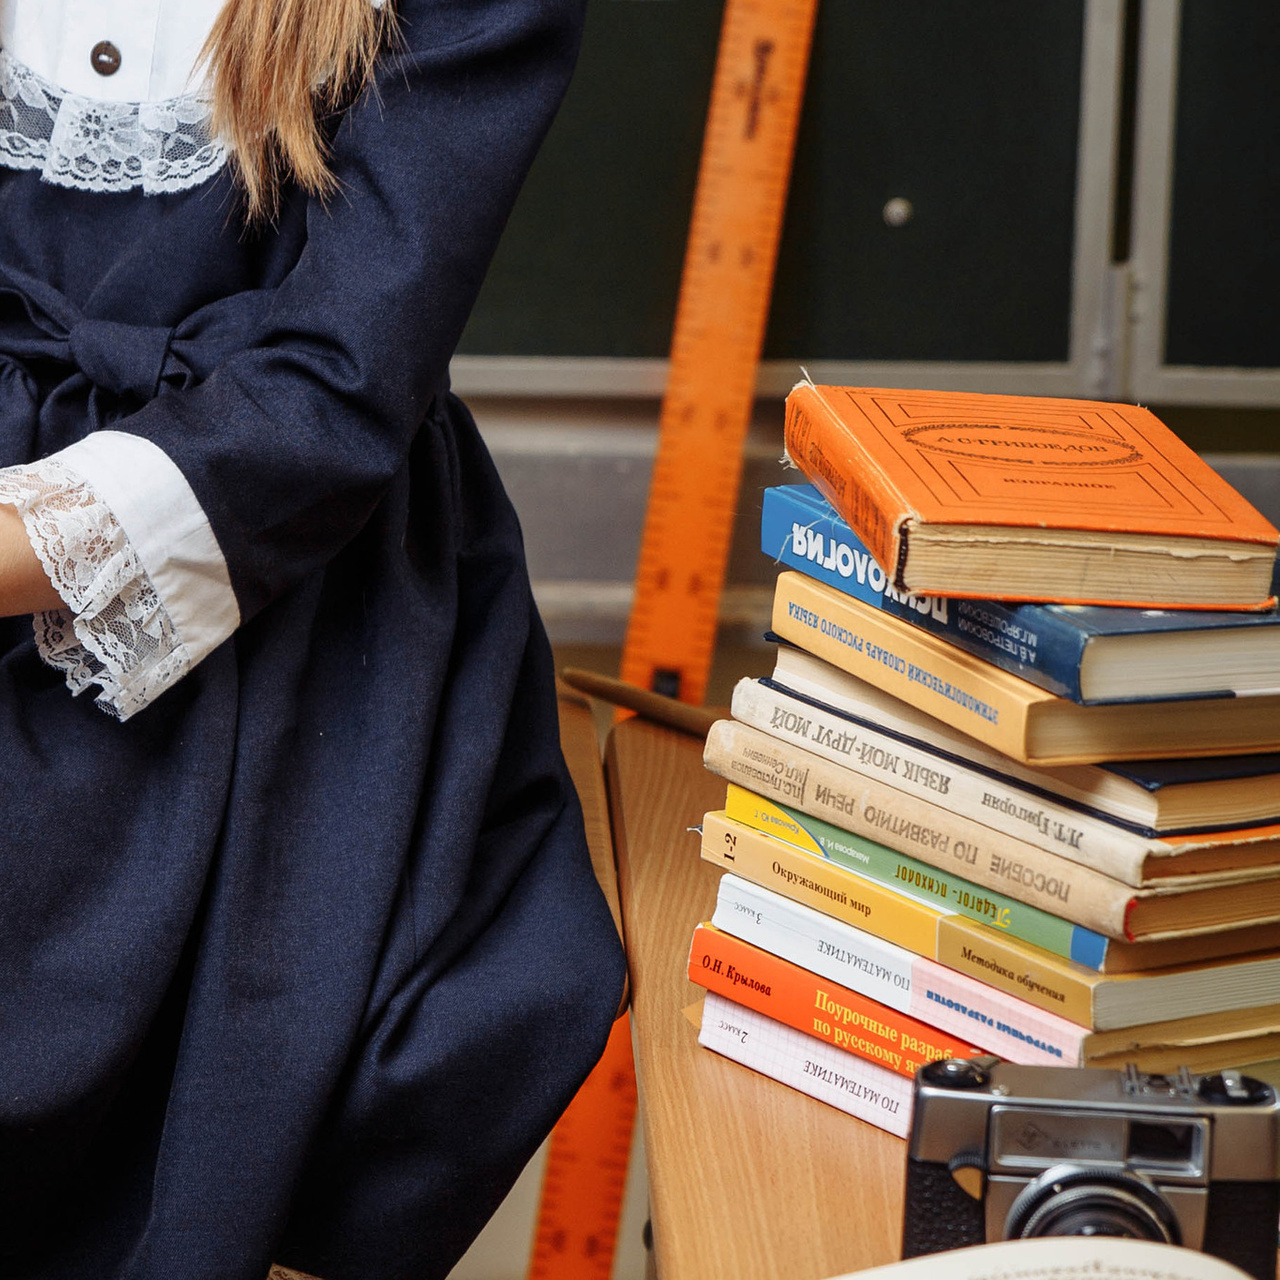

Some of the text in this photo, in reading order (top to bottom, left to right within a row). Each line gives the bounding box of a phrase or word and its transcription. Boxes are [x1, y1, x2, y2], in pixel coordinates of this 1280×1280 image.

[788, 601, 999, 726] ЭТИМОЛОГИЧЕСКИЙ СЛОВАРЬ РУССКОГО ЯЗЫКА
[769, 706, 812, 739] МОЙ
[902, 760, 951, 795] ЯЗЫК
[981, 792, 1050, 837] Григорян
[814, 783, 1072, 903] ПОСОБИЕ ПО РАЗВИТИЮ РЕЧИ
[771, 860, 873, 918] Окружающий мир
[755, 912, 763, 925] 3
[726, 965, 773, 997] Крылова
[816, 939, 892, 983] МАТЕМАТИКЕ
[893, 973, 911, 992] ПО
[960, 945, 1066, 1004] Методика обучения
[813, 989, 955, 1063] Поурочные разраб
[925, 989, 994, 1026] РАЗРАБОТКИ
[740, 1031, 749, 1044] 2
[812, 1017, 831, 1036] по
[833, 1026, 903, 1070] русскому
[802, 1060, 881, 1106] МАТЕМАТИКЕ
[881, 1095, 900, 1115] ПО
